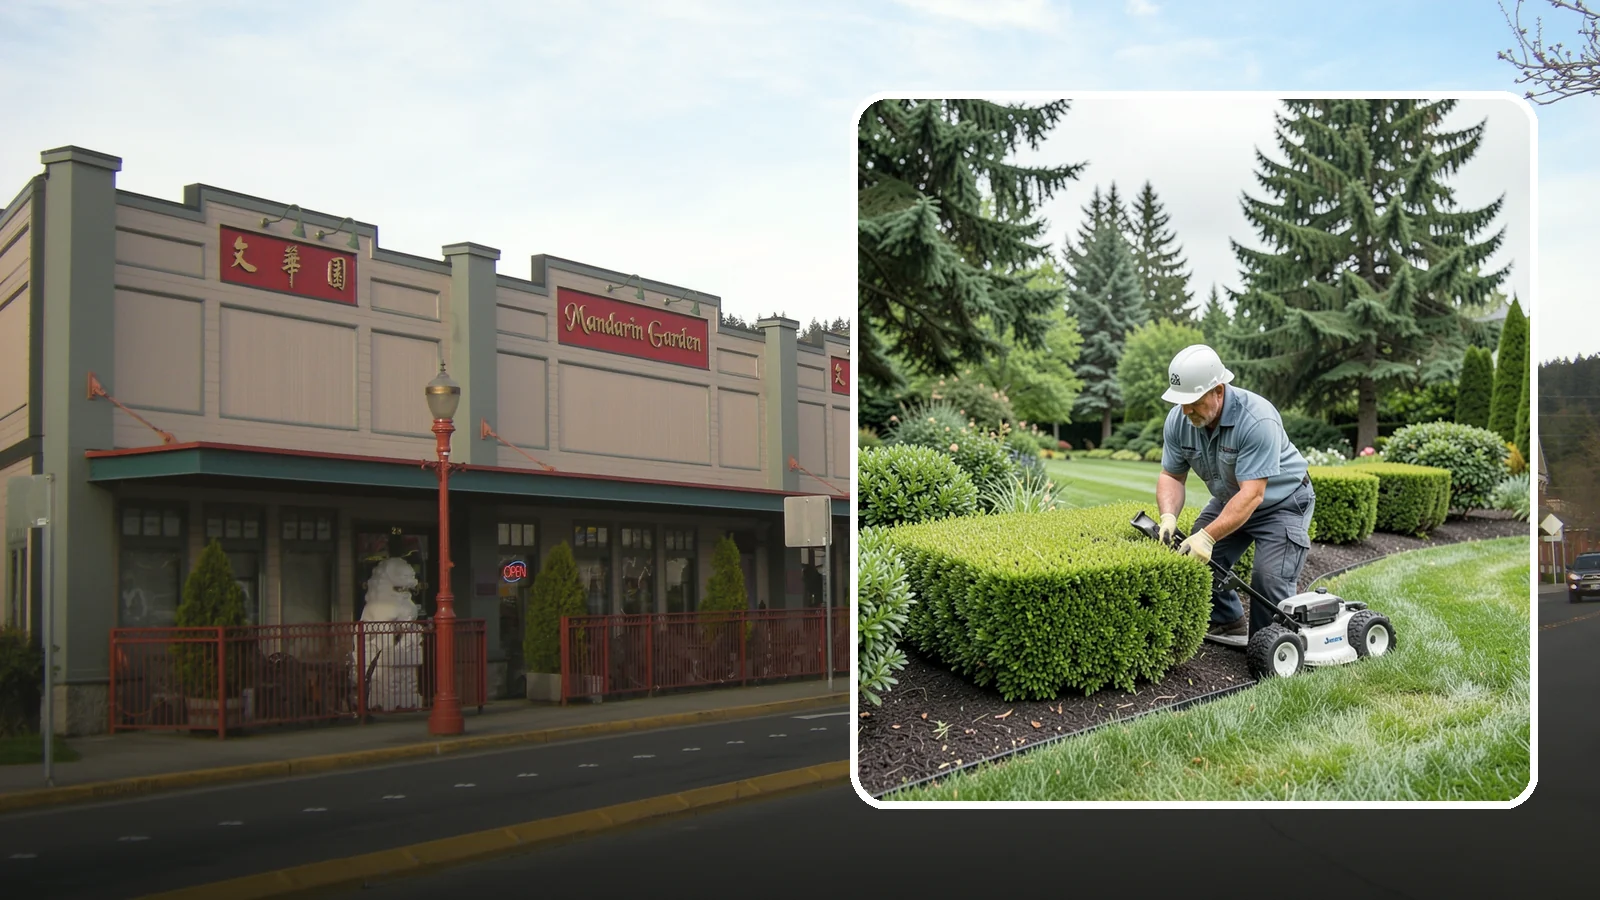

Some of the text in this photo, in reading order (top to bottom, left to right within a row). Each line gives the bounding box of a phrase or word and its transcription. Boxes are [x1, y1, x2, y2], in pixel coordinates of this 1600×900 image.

[564, 302, 701, 352] Mandarin Garden
[503, 565, 527, 578] OPEN
